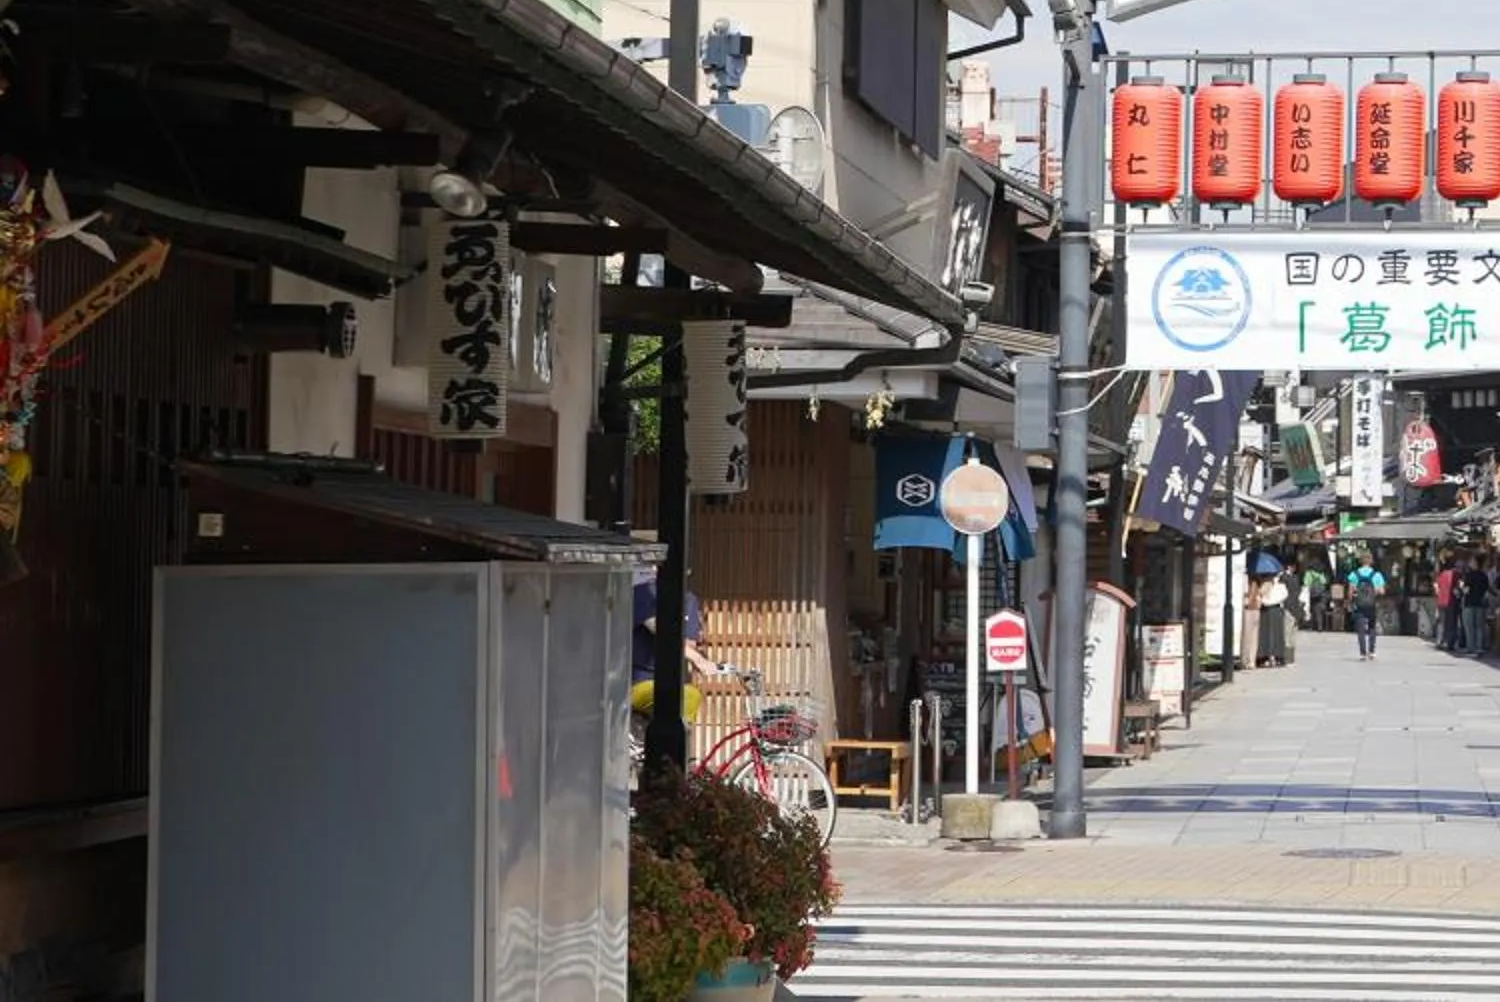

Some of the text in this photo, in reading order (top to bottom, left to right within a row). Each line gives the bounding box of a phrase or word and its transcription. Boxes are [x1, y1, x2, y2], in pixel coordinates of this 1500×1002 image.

[1127, 103, 1149, 175] 丸仁
[1209, 104, 1230, 176] 中村堂
[1370, 103, 1391, 175] 延命堂
[1453, 101, 1475, 174] 川千家
